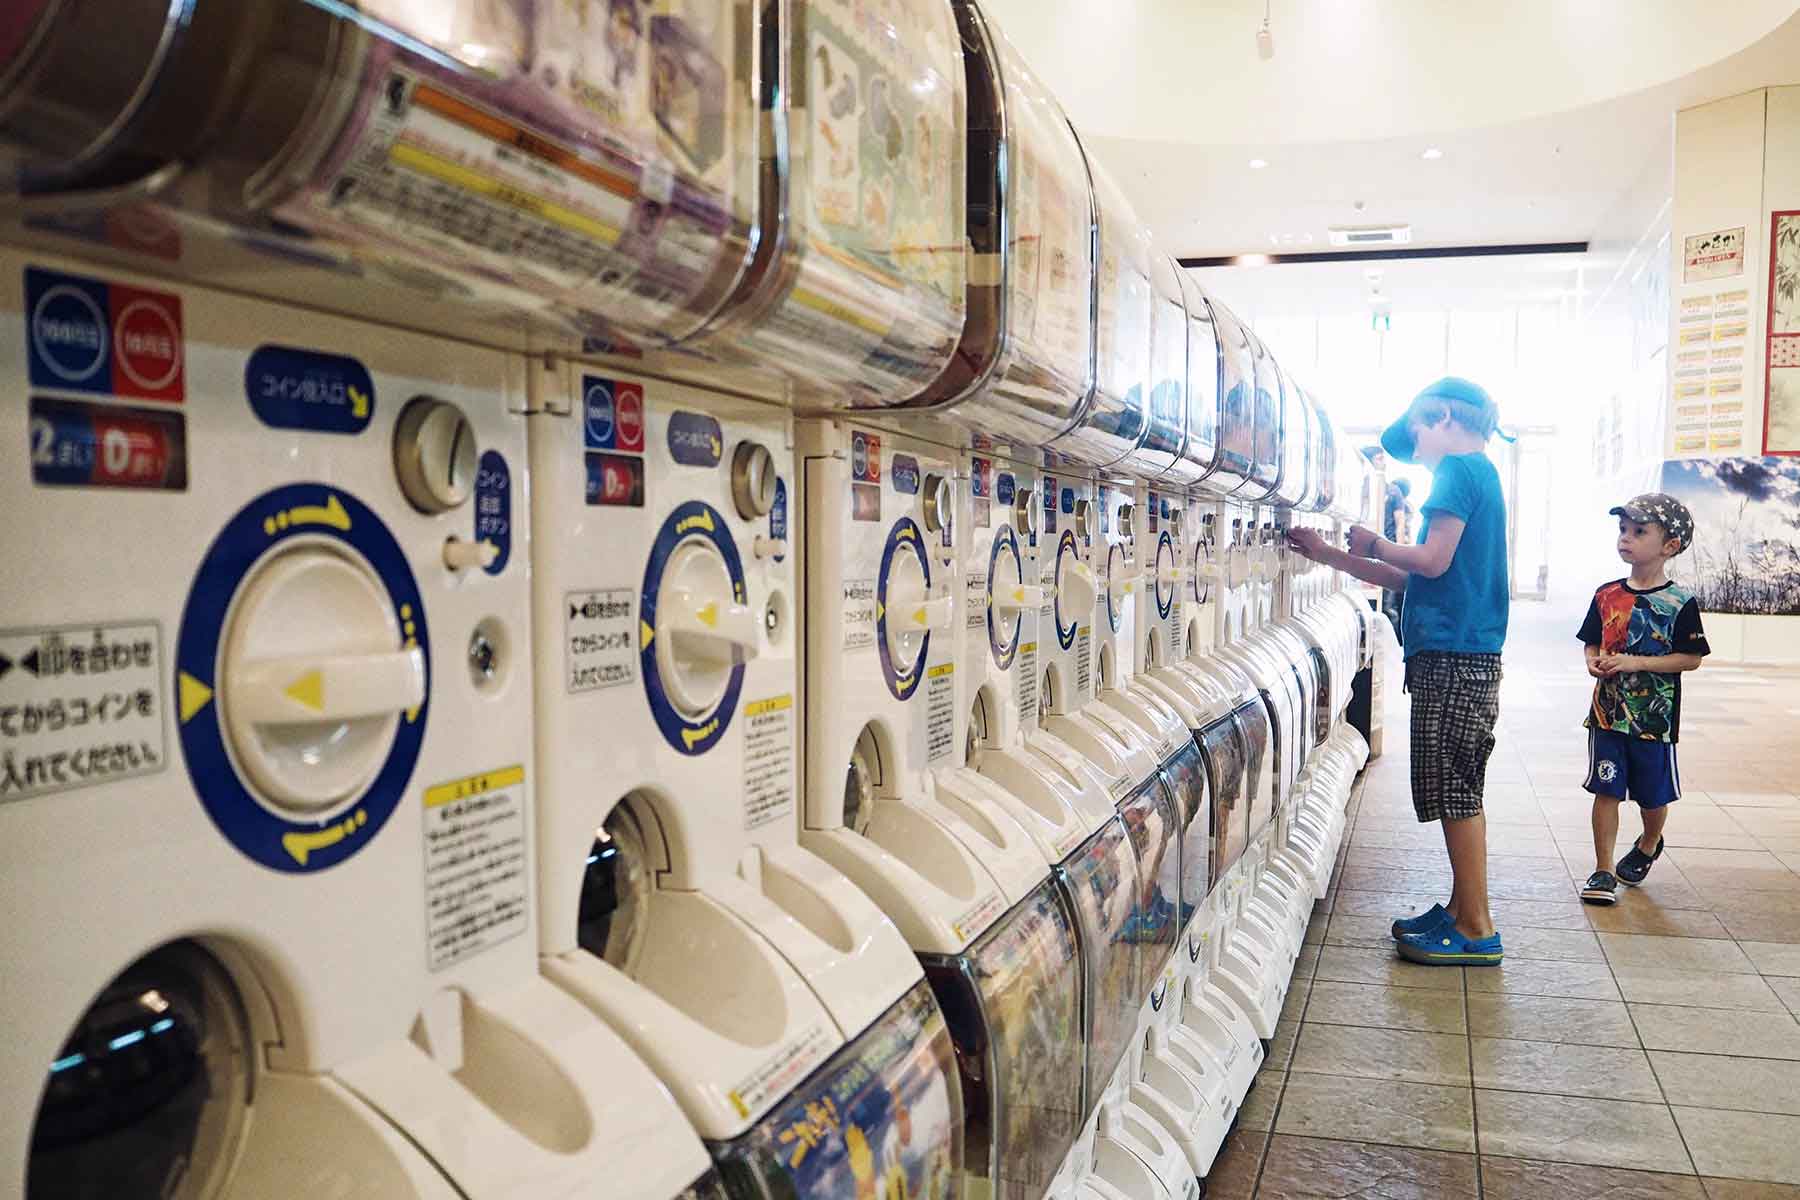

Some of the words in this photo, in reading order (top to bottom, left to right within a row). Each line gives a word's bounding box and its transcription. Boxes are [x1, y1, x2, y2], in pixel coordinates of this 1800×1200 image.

[0, 690, 152, 737] てからコインを
